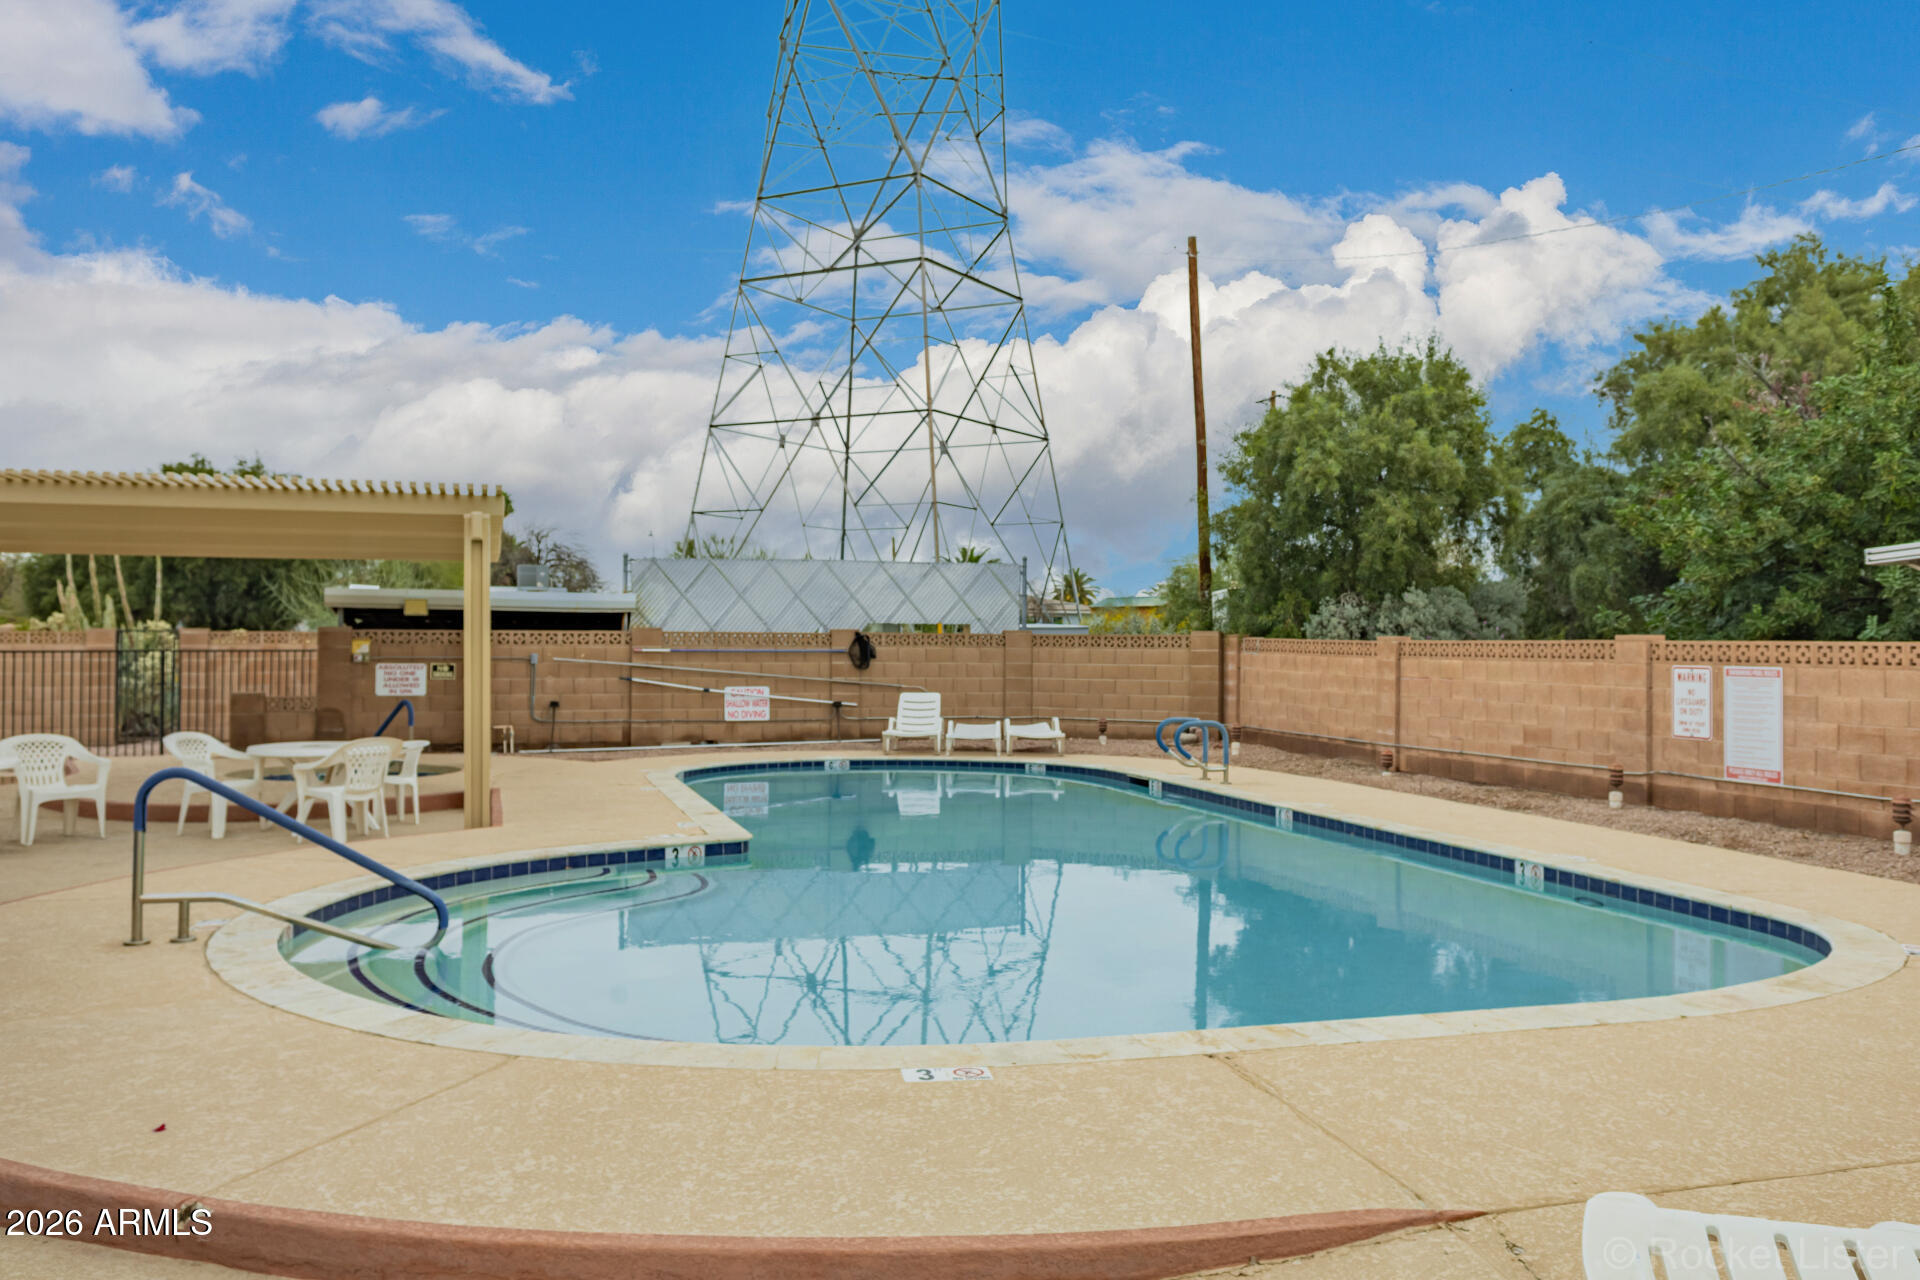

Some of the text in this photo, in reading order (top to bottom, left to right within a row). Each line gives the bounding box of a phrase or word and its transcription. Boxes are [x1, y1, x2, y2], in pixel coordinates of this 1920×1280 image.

[1677, 672, 1706, 684] WARNING
[726, 699, 769, 708] SHALLOW WATER
[728, 710, 767, 719] NO DIVING
[916, 1068, 935, 1081] 3
